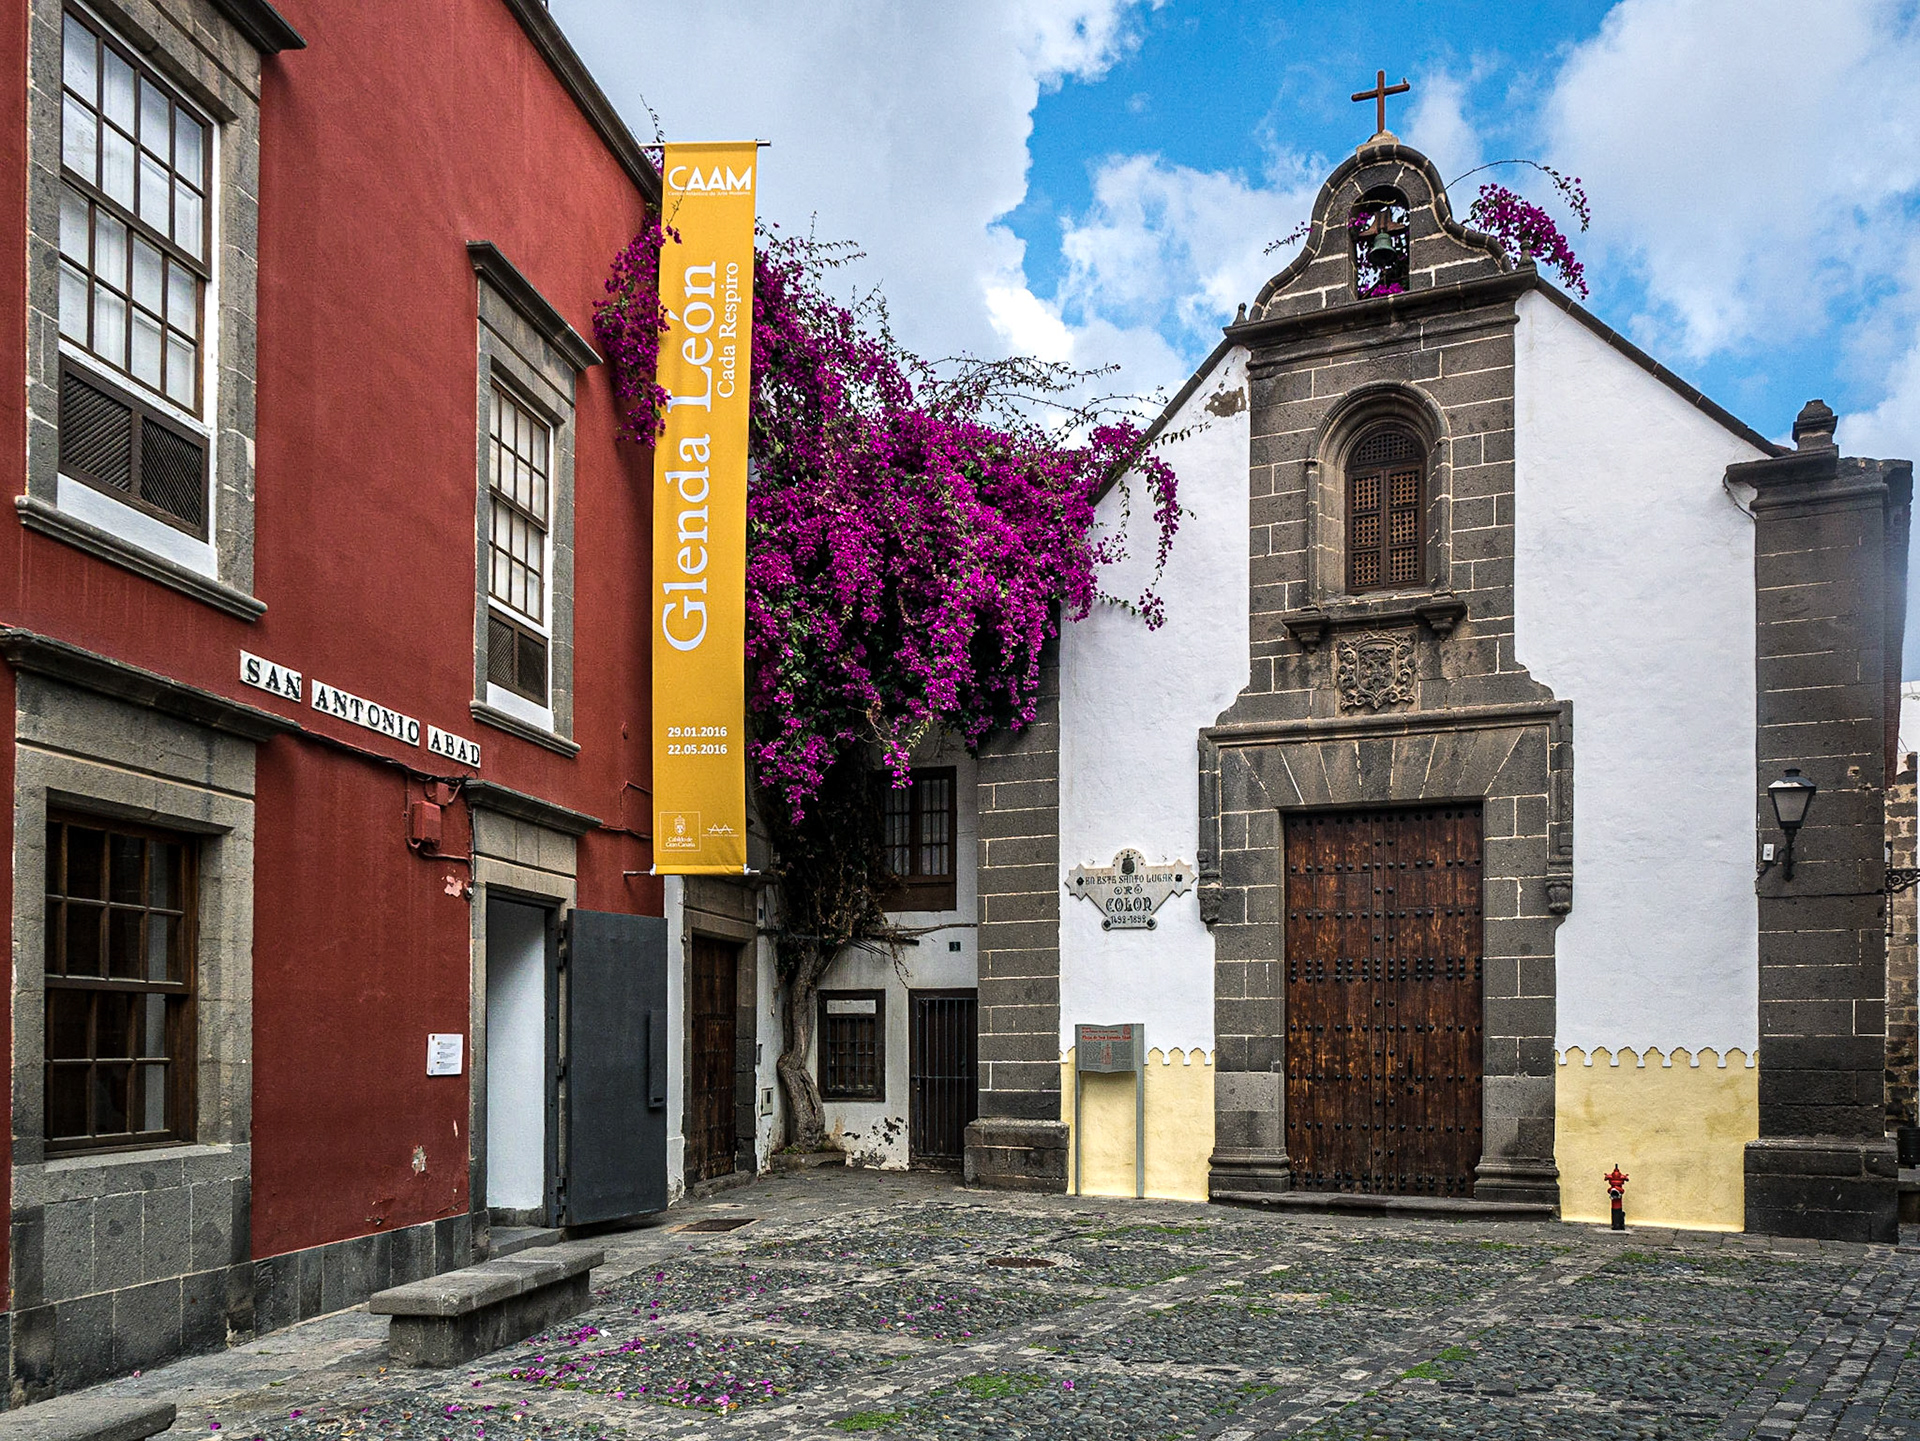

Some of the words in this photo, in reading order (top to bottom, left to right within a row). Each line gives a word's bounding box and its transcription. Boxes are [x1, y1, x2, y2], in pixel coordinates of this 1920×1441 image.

[668, 166, 752, 191] CAAM
[719, 262, 742, 339] Respiro
[666, 261, 716, 414] León
[717, 345, 736, 398] Cada
[662, 433, 711, 652] Glenda
[246, 658, 302, 699] SAN
[315, 685, 420, 742] ANTONIO
[430, 730, 480, 765] ABAD
[667, 727, 728, 737] 29.01.2016
[667, 744, 728, 754] 22.05.2016
[1097, 876, 1117, 885] ESTE
[1118, 874, 1145, 884] SANTO
[1146, 873, 1173, 883] LUGAR
[1110, 914, 1147, 924] 1492-1892
